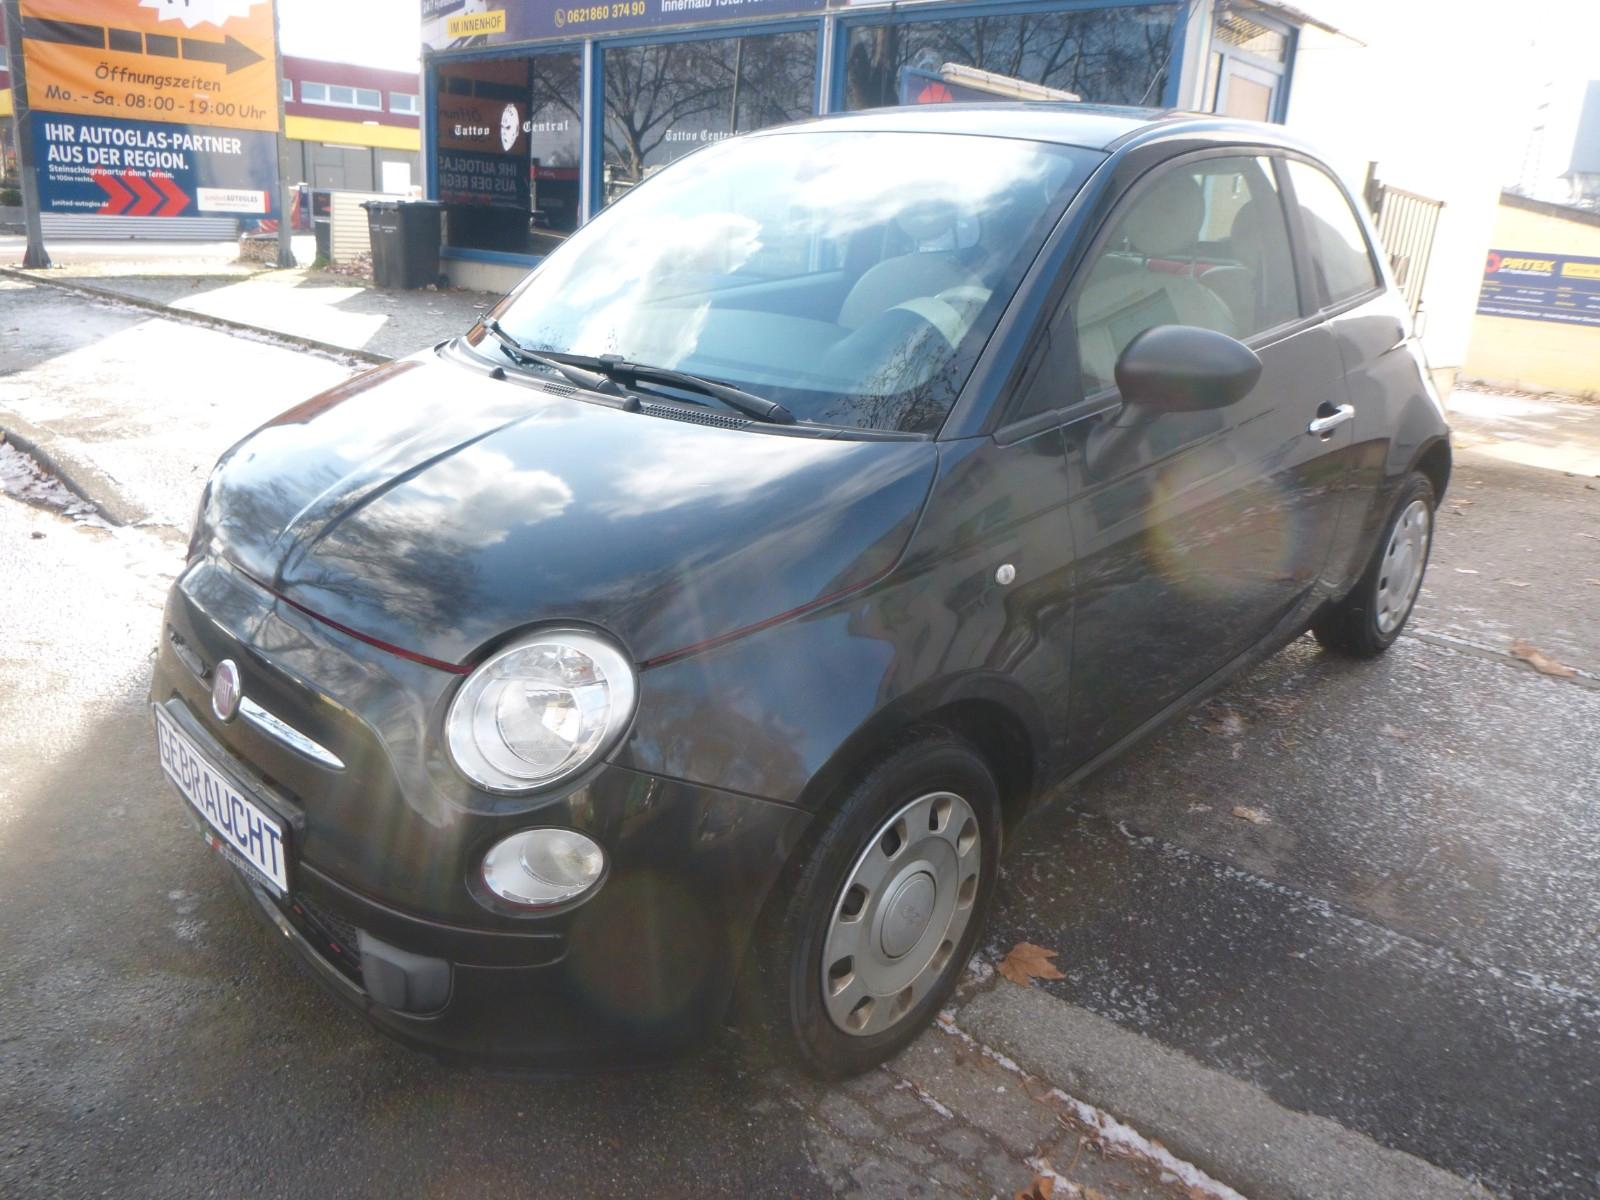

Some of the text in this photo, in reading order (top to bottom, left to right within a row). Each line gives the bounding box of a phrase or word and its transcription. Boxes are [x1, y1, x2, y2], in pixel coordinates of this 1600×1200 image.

[450, 16, 501, 33] IM INNENHOF
[95, 62, 221, 92] Öffnungszeiten
[125, 93, 174, 111] 08:00
[189, 99, 235, 117] 19:00
[239, 104, 266, 120] Uhr
[45, 123, 241, 155] IHR AUTOGLAS-PARTNER
[454, 120, 568, 136] Tattoo Central
[665, 130, 697, 141] Tattoo
[48, 144, 189, 170] AUS DER REGION.
[159, 721, 280, 877] GEBRAUCHT
